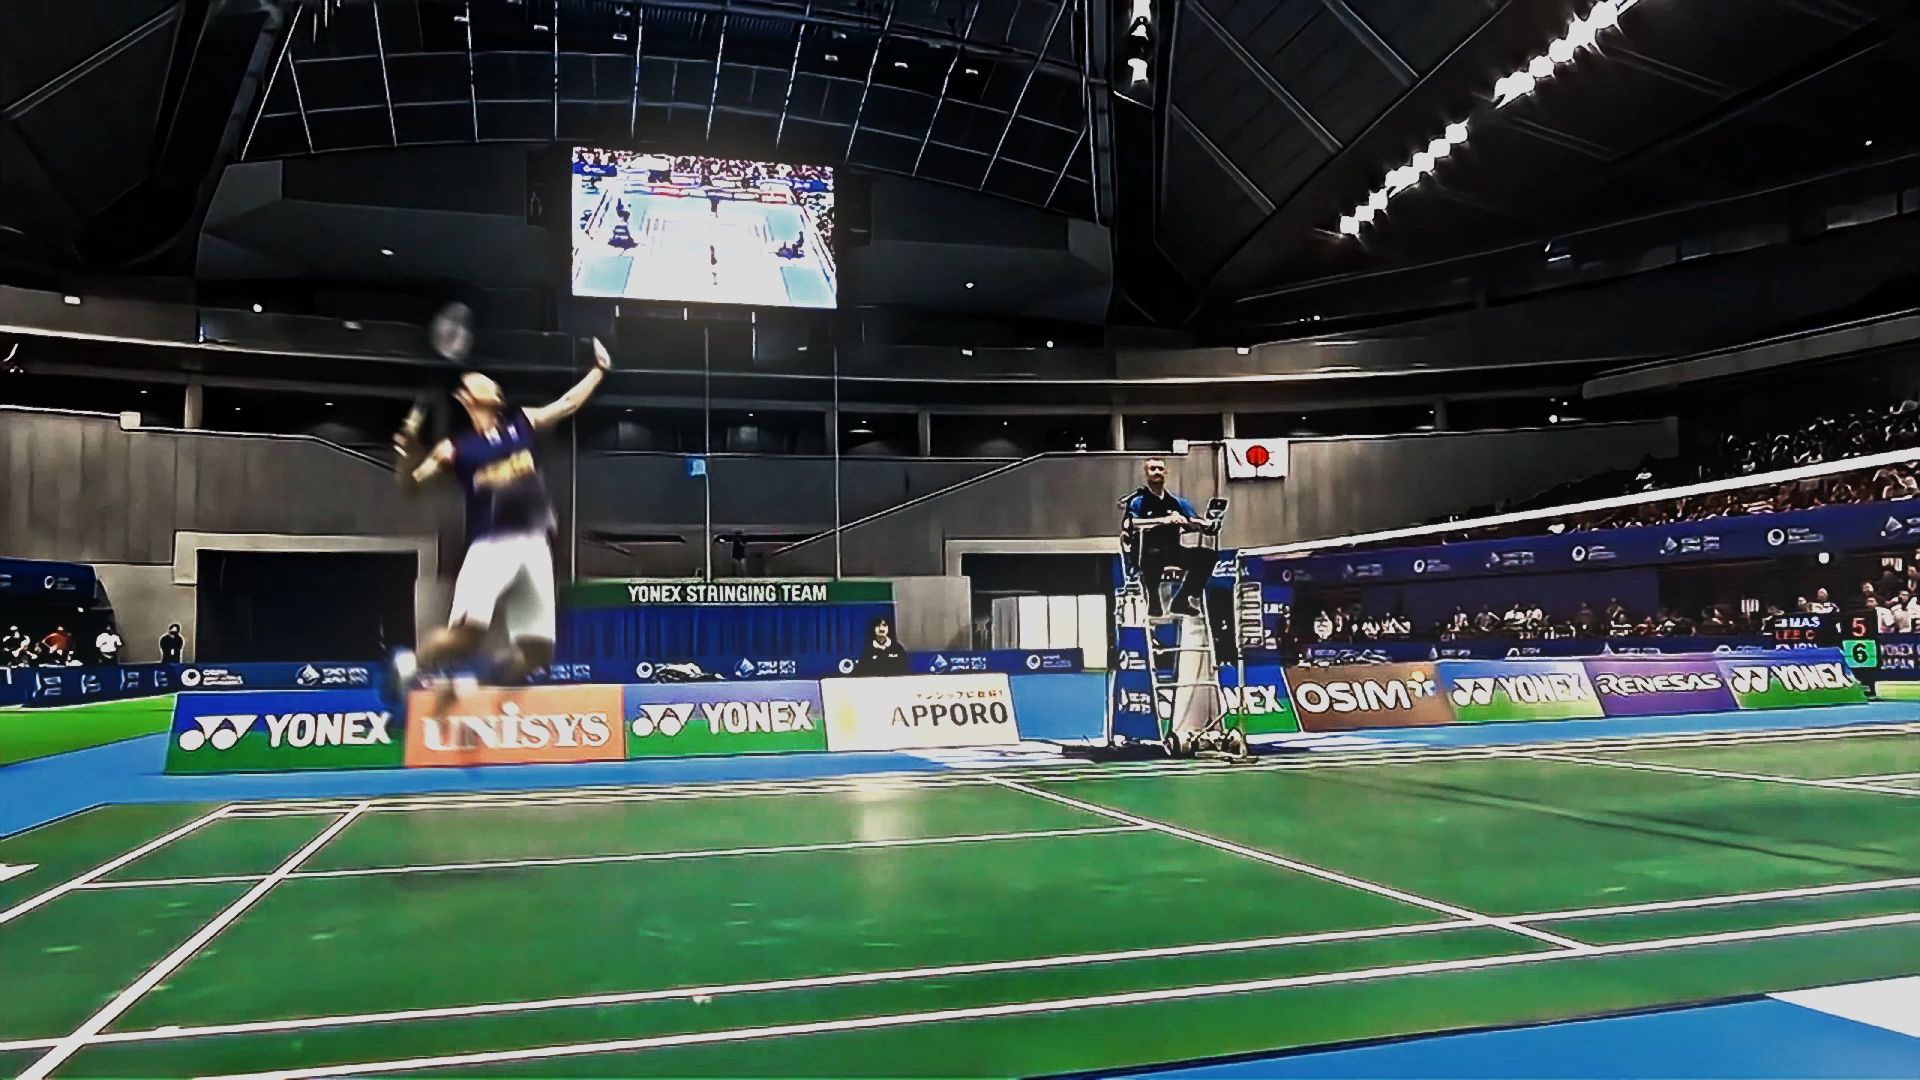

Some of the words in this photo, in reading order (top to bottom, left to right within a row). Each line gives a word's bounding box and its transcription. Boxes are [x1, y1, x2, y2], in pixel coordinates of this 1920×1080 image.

[628, 585, 682, 603] YONEX
[686, 584, 777, 603] STRINGING
[782, 584, 827, 601] TEAM
[1851, 617, 1867, 638] 5
[1851, 642, 1869, 664] 6
[1503, 672, 1593, 706] YONEX
[1770, 662, 1854, 692] YONEX
[1220, 684, 1283, 715] NEX
[1294, 679, 1412, 713] OSIM
[265, 711, 394, 748] YONEX
[702, 700, 816, 734] YONEX
